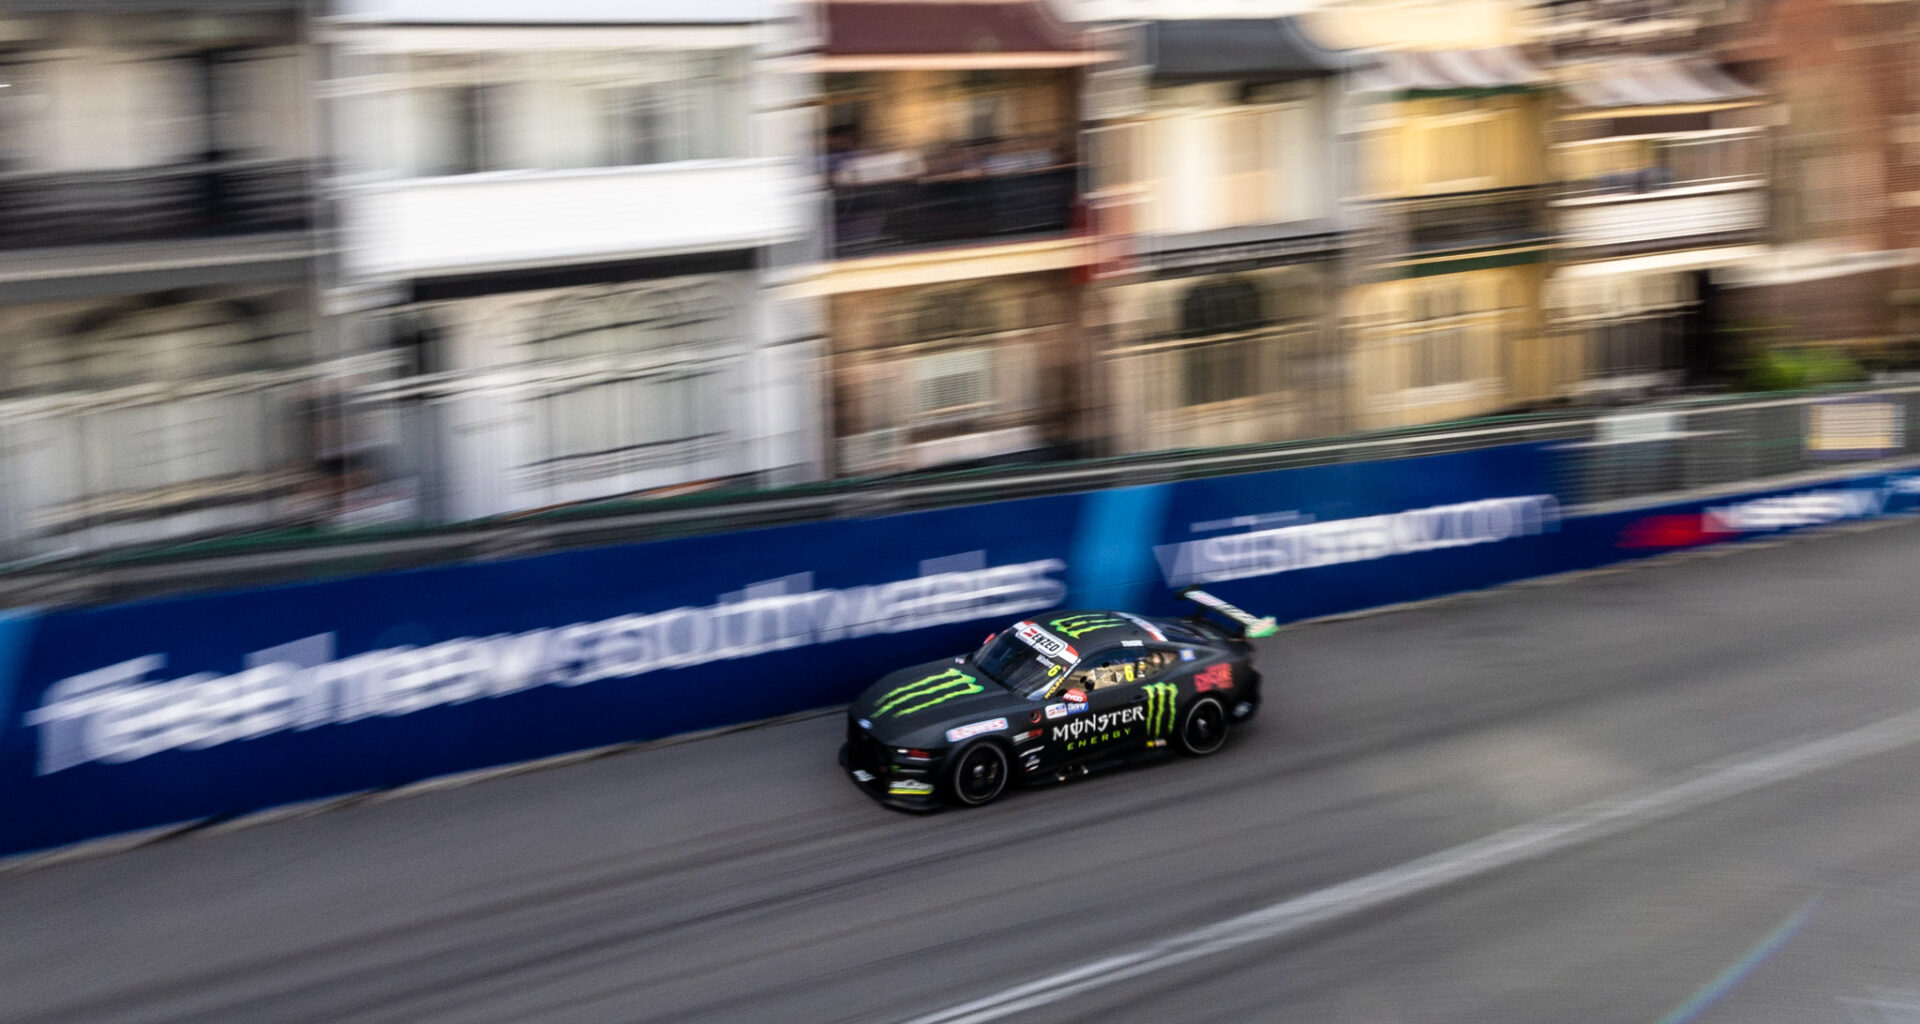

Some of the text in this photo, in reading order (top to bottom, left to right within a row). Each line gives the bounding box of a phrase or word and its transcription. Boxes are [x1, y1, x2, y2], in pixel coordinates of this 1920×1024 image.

[1032, 632, 1060, 652] ENZED
[1047, 664, 1062, 678] 6
[1124, 665, 1134, 682] 6
[1066, 727, 1131, 751] ENERGY
